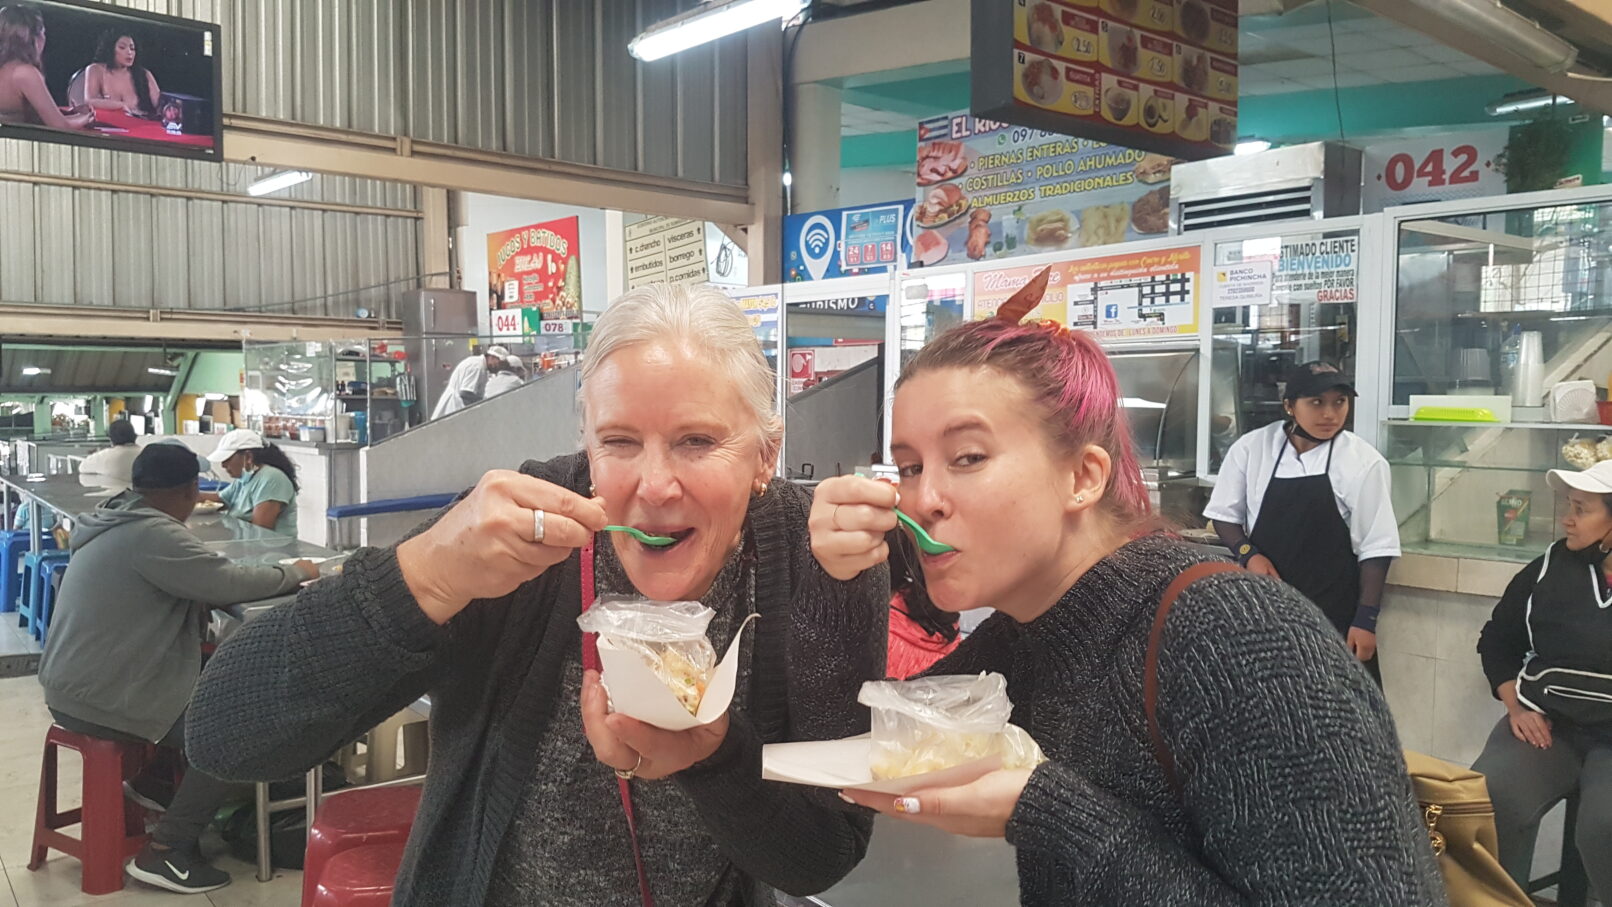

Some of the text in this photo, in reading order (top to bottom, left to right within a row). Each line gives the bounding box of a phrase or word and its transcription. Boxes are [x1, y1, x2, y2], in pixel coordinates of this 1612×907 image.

[951, 115, 971, 139] EL
[978, 138, 1078, 171] PIERNAS ENTERAS
[966, 148, 1145, 192] COSTILLAS POLLO AHUMADO
[1384, 144, 1480, 192] 042
[971, 171, 1135, 209] ALMUERZOS TRADICIONALES
[879, 213, 896, 224] PLUS
[521, 229, 529, 248] Y
[529, 228, 568, 258] BATIDOS
[1280, 239, 1356, 258] STIMADO CLIENTE
[669, 250, 695, 264] borrego
[1278, 253, 1351, 273] BIENVENIDO
[634, 259, 663, 273] embutidos
[1229, 268, 1254, 276] BANCO
[1229, 273, 1267, 281] PICHINCHA
[1323, 278, 1335, 289] POR
[1336, 277, 1354, 288] FAVOR
[1317, 288, 1355, 302] GRACIAS
[497, 314, 517, 332] 044
[544, 322, 564, 333] 078
[1152, 325, 1178, 335] DOMINGO
